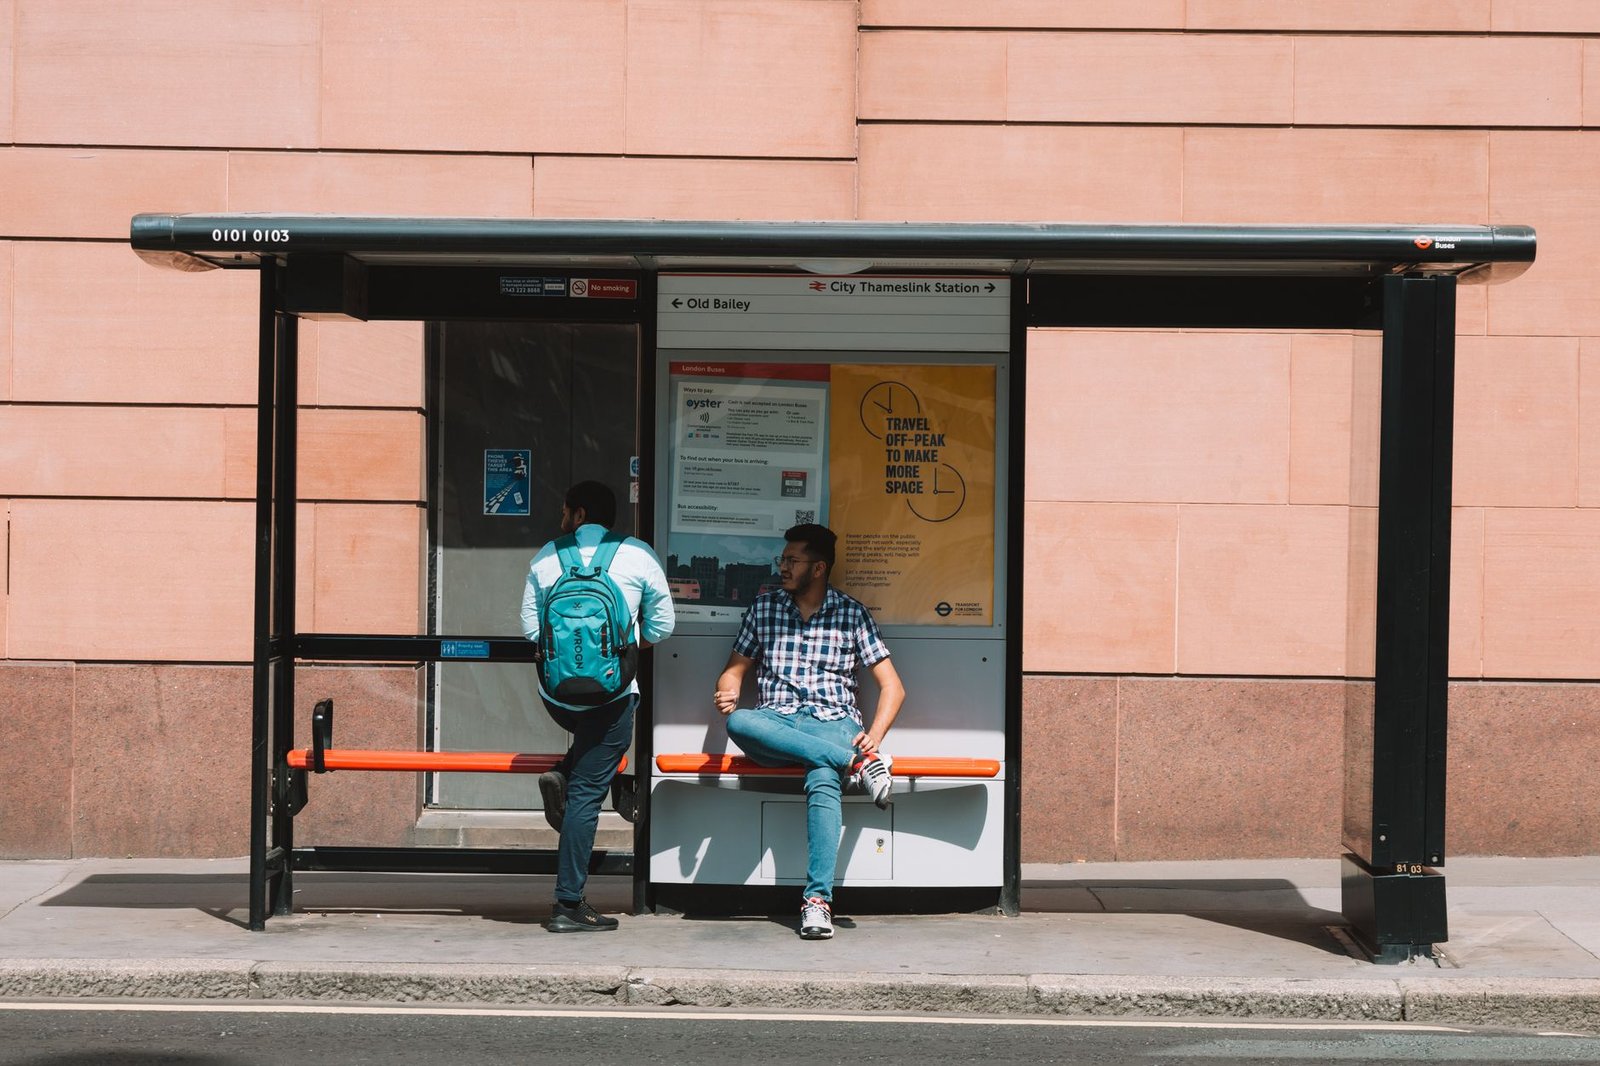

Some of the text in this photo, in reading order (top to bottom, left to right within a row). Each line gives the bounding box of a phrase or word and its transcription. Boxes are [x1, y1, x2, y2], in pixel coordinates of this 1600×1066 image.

[212, 229, 290, 242] 0101 0103
[603, 285, 630, 293] smoking
[830, 281, 979, 293] City Thameslink Station
[687, 298, 750, 311] Old Bailey
[686, 398, 722, 410] oyster
[885, 417, 930, 431] TRAVEL
[886, 434, 946, 447] OFF-PEAK
[885, 449, 938, 463] TO MAKE
[886, 465, 920, 478] MORE
[885, 481, 923, 494] SPACE
[573, 626, 584, 669] WROGN
[1396, 864, 1422, 874] 81 03
